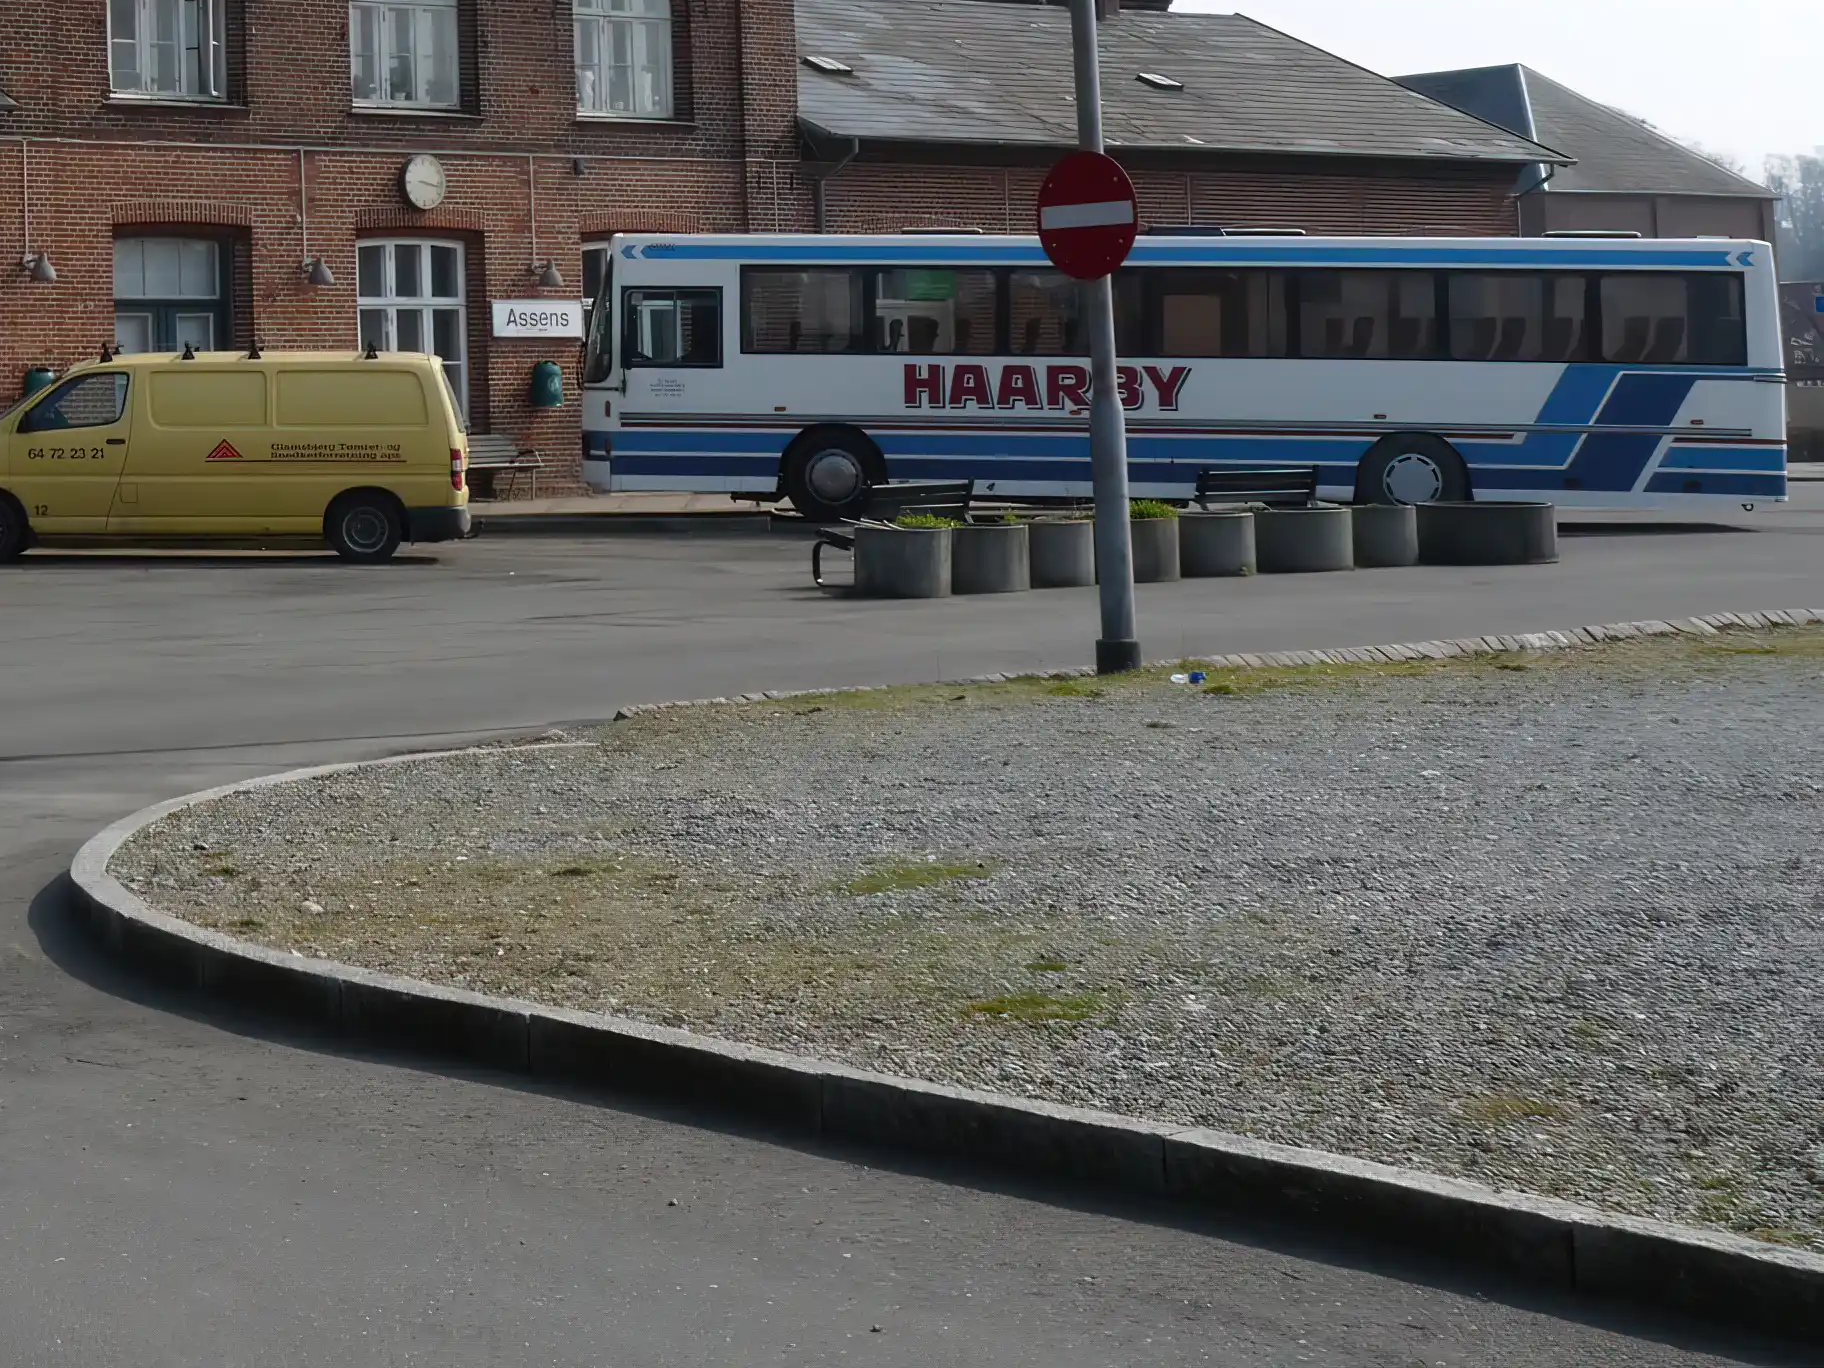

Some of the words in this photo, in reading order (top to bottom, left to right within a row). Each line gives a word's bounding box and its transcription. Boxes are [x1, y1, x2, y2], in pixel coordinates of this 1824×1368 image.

[506, 308, 569, 327] Assens
[904, 364, 1192, 411] HAARBY
[28, 448, 44, 459] 64
[49, 448, 65, 459] 72
[70, 448, 86, 459] 23
[90, 448, 104, 459] 21
[34, 505, 48, 516] 12
